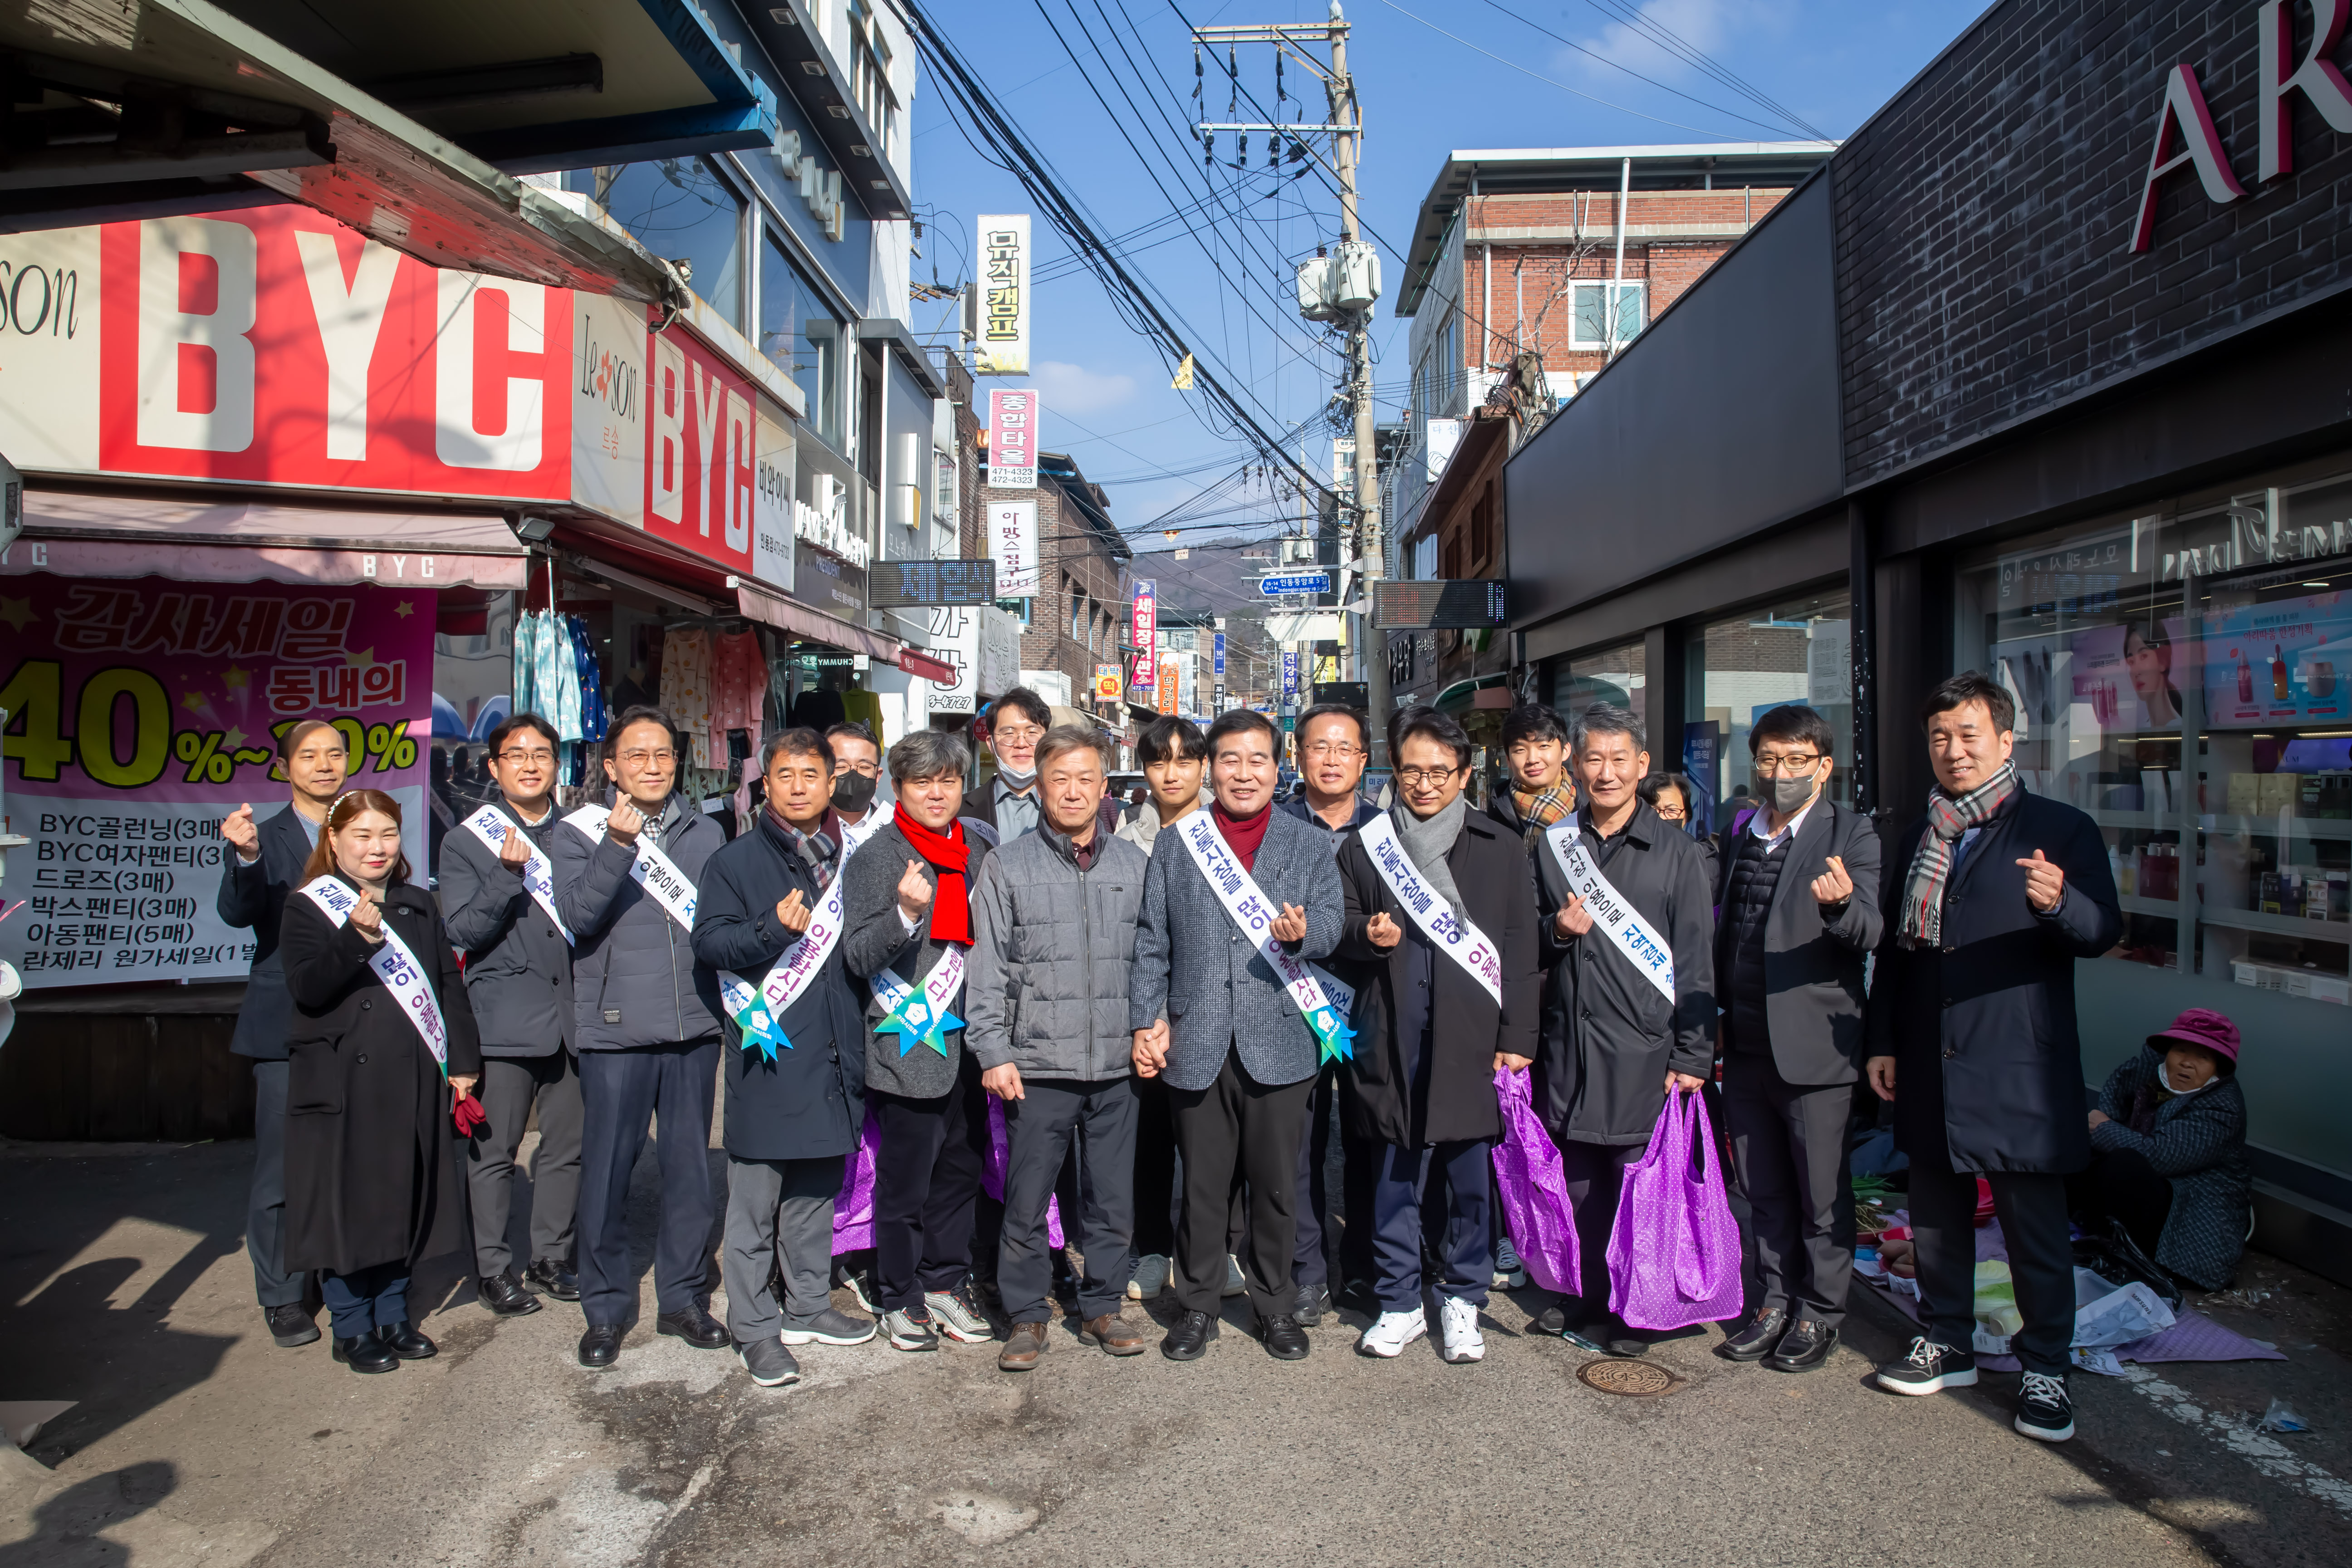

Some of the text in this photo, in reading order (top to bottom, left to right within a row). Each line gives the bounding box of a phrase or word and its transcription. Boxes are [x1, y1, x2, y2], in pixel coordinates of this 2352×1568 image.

[986, 230, 1019, 342] 뮤직캠프
[137, 216, 544, 472] BYC
[999, 394, 1028, 465] 종합타올
[652, 339, 752, 555] BYC
[760, 460, 790, 516] 비와이씨
[363, 554, 434, 578] BYC
[816, 555, 840, 580] PRESIDENT
[54, 585, 355, 662] 감사세일
[1098, 666, 1119, 676] 대박
[1162, 666, 1177, 676] 불로
[1284, 653, 1296, 688] 건강원
[266, 660, 406, 714] 동내의
[1103, 681, 1115, 693] 떡
[37, 840, 226, 868] BYC여자팬티(3
[32, 868, 174, 894] 드로즈(3매)
[1188, 818, 1244, 896] 전통시장을
[1236, 895, 1272, 930] 많이
[1374, 836, 1434, 915] 전통시장을
[31, 896, 197, 921] 박스팬티(3매)
[1559, 833, 1587, 878] 전통시장
[1583, 877, 1626, 927] 이용으로
[1622, 923, 1668, 971] 지역경제
[27, 922, 194, 946] 아동팬티(5매)
[23, 949, 103, 971] 란제리
[381, 951, 418, 986] 많이
[765, 923, 833, 1006] 이용합시다
[747, 1024, 772, 1040] 구미시의회
[896, 1013, 919, 1036] 구미시의회
[2132, 1293, 2152, 1315] SAMSUNG
